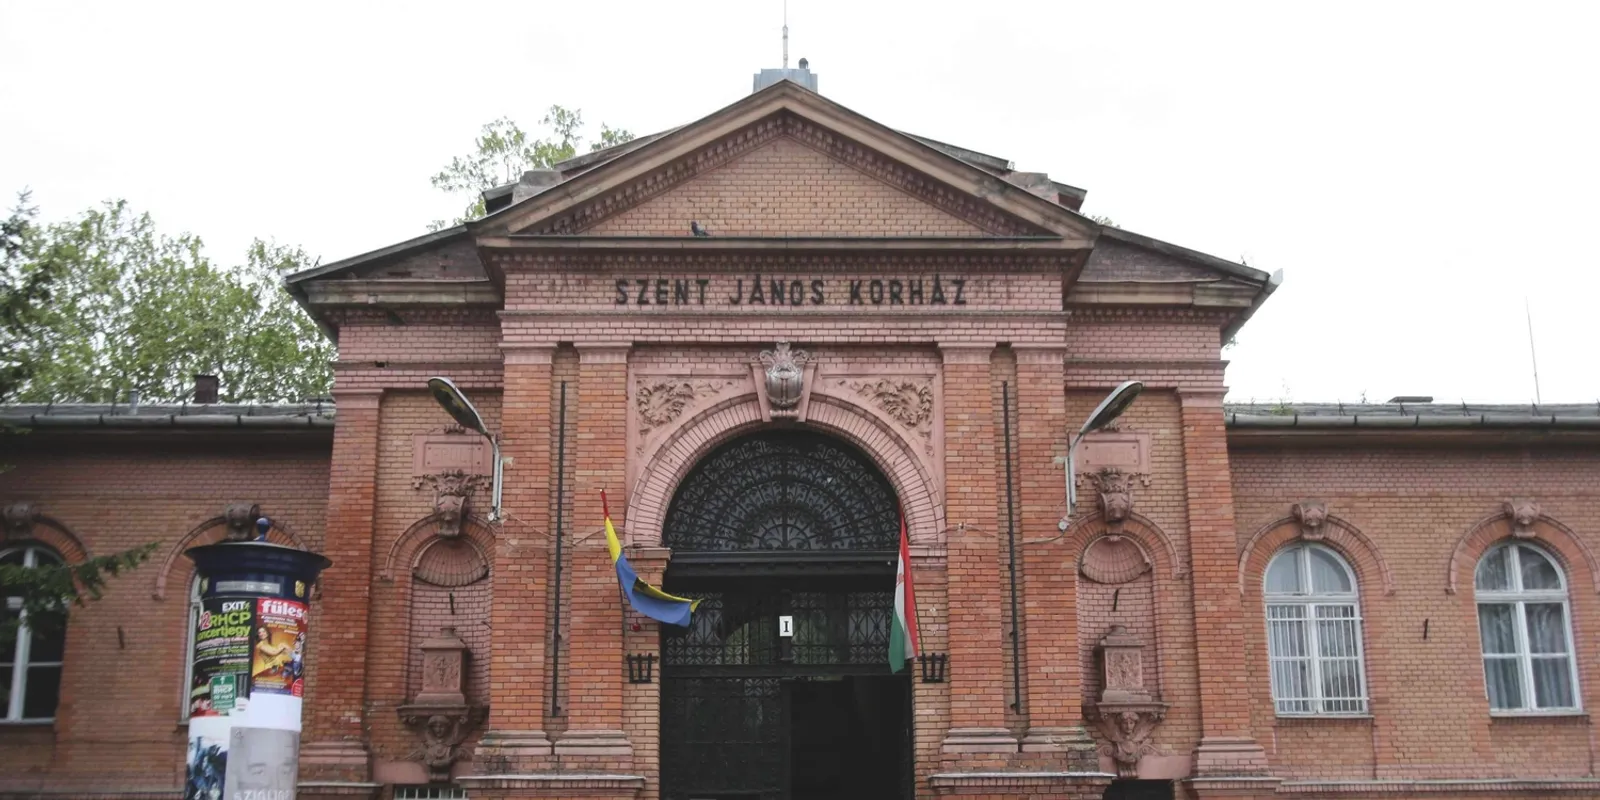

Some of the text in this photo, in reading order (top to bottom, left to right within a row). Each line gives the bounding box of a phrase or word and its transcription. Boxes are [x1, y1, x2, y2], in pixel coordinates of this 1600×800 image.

[615, 273, 966, 305] SZENT JÁNOS KORHÁZ
[222, 600, 246, 613] EXIT
[261, 600, 303, 618] füles
[210, 611, 251, 627] RHCP
